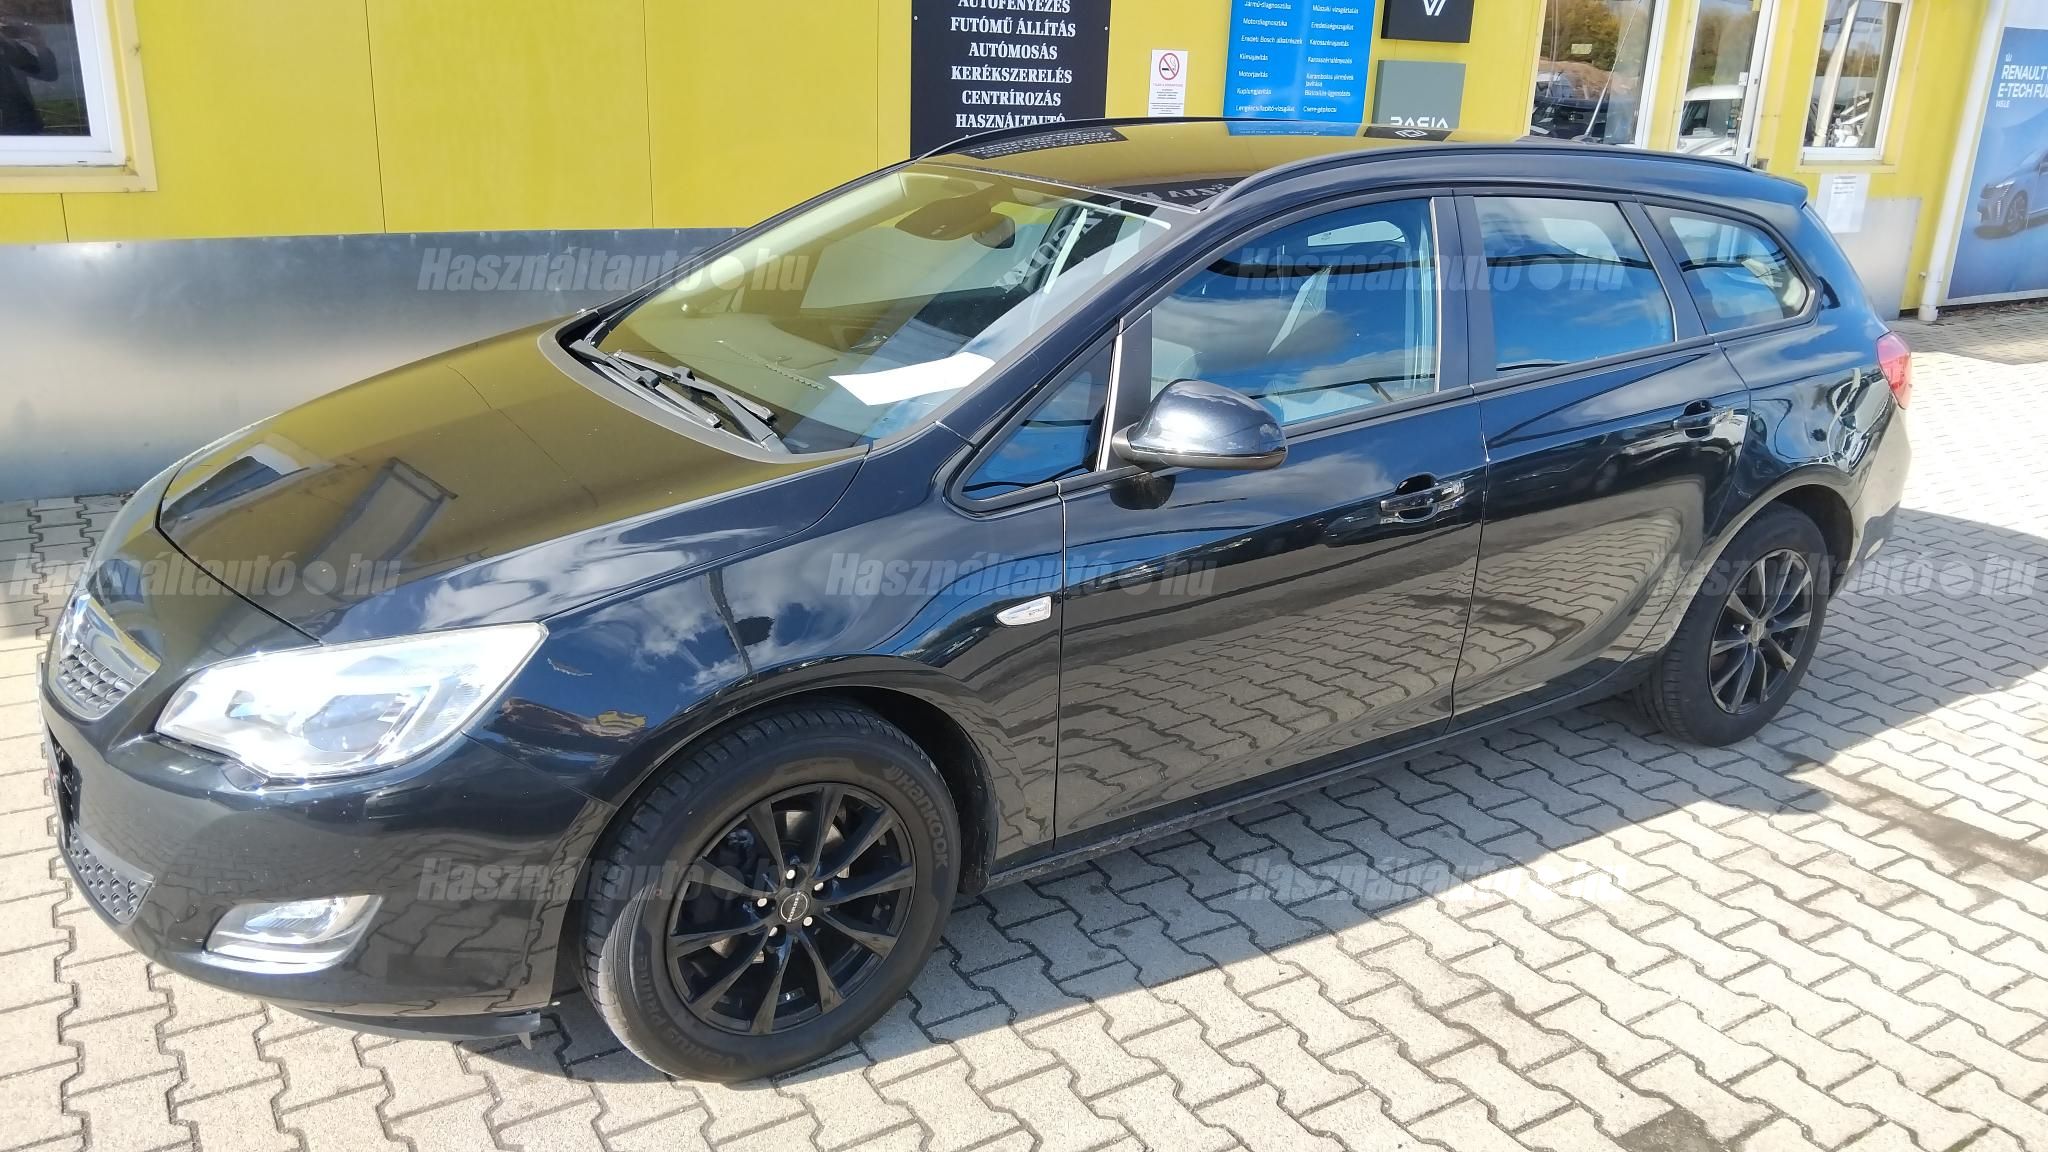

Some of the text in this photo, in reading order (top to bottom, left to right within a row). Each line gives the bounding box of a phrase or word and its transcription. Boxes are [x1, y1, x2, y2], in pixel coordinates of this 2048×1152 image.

[950, 16, 1077, 38] FUTÓMŰ ÁLLÍTÁS
[968, 41, 1058, 60] AUTÓMOSÁS
[951, 64, 1073, 83] KERÉKSZERELÉS
[2001, 64, 2047, 80] RENAULT
[961, 89, 1062, 106] CENTRÍROZÁS
[1997, 83, 2033, 98] E-TECH
[1390, 116, 1449, 128] DACIA
